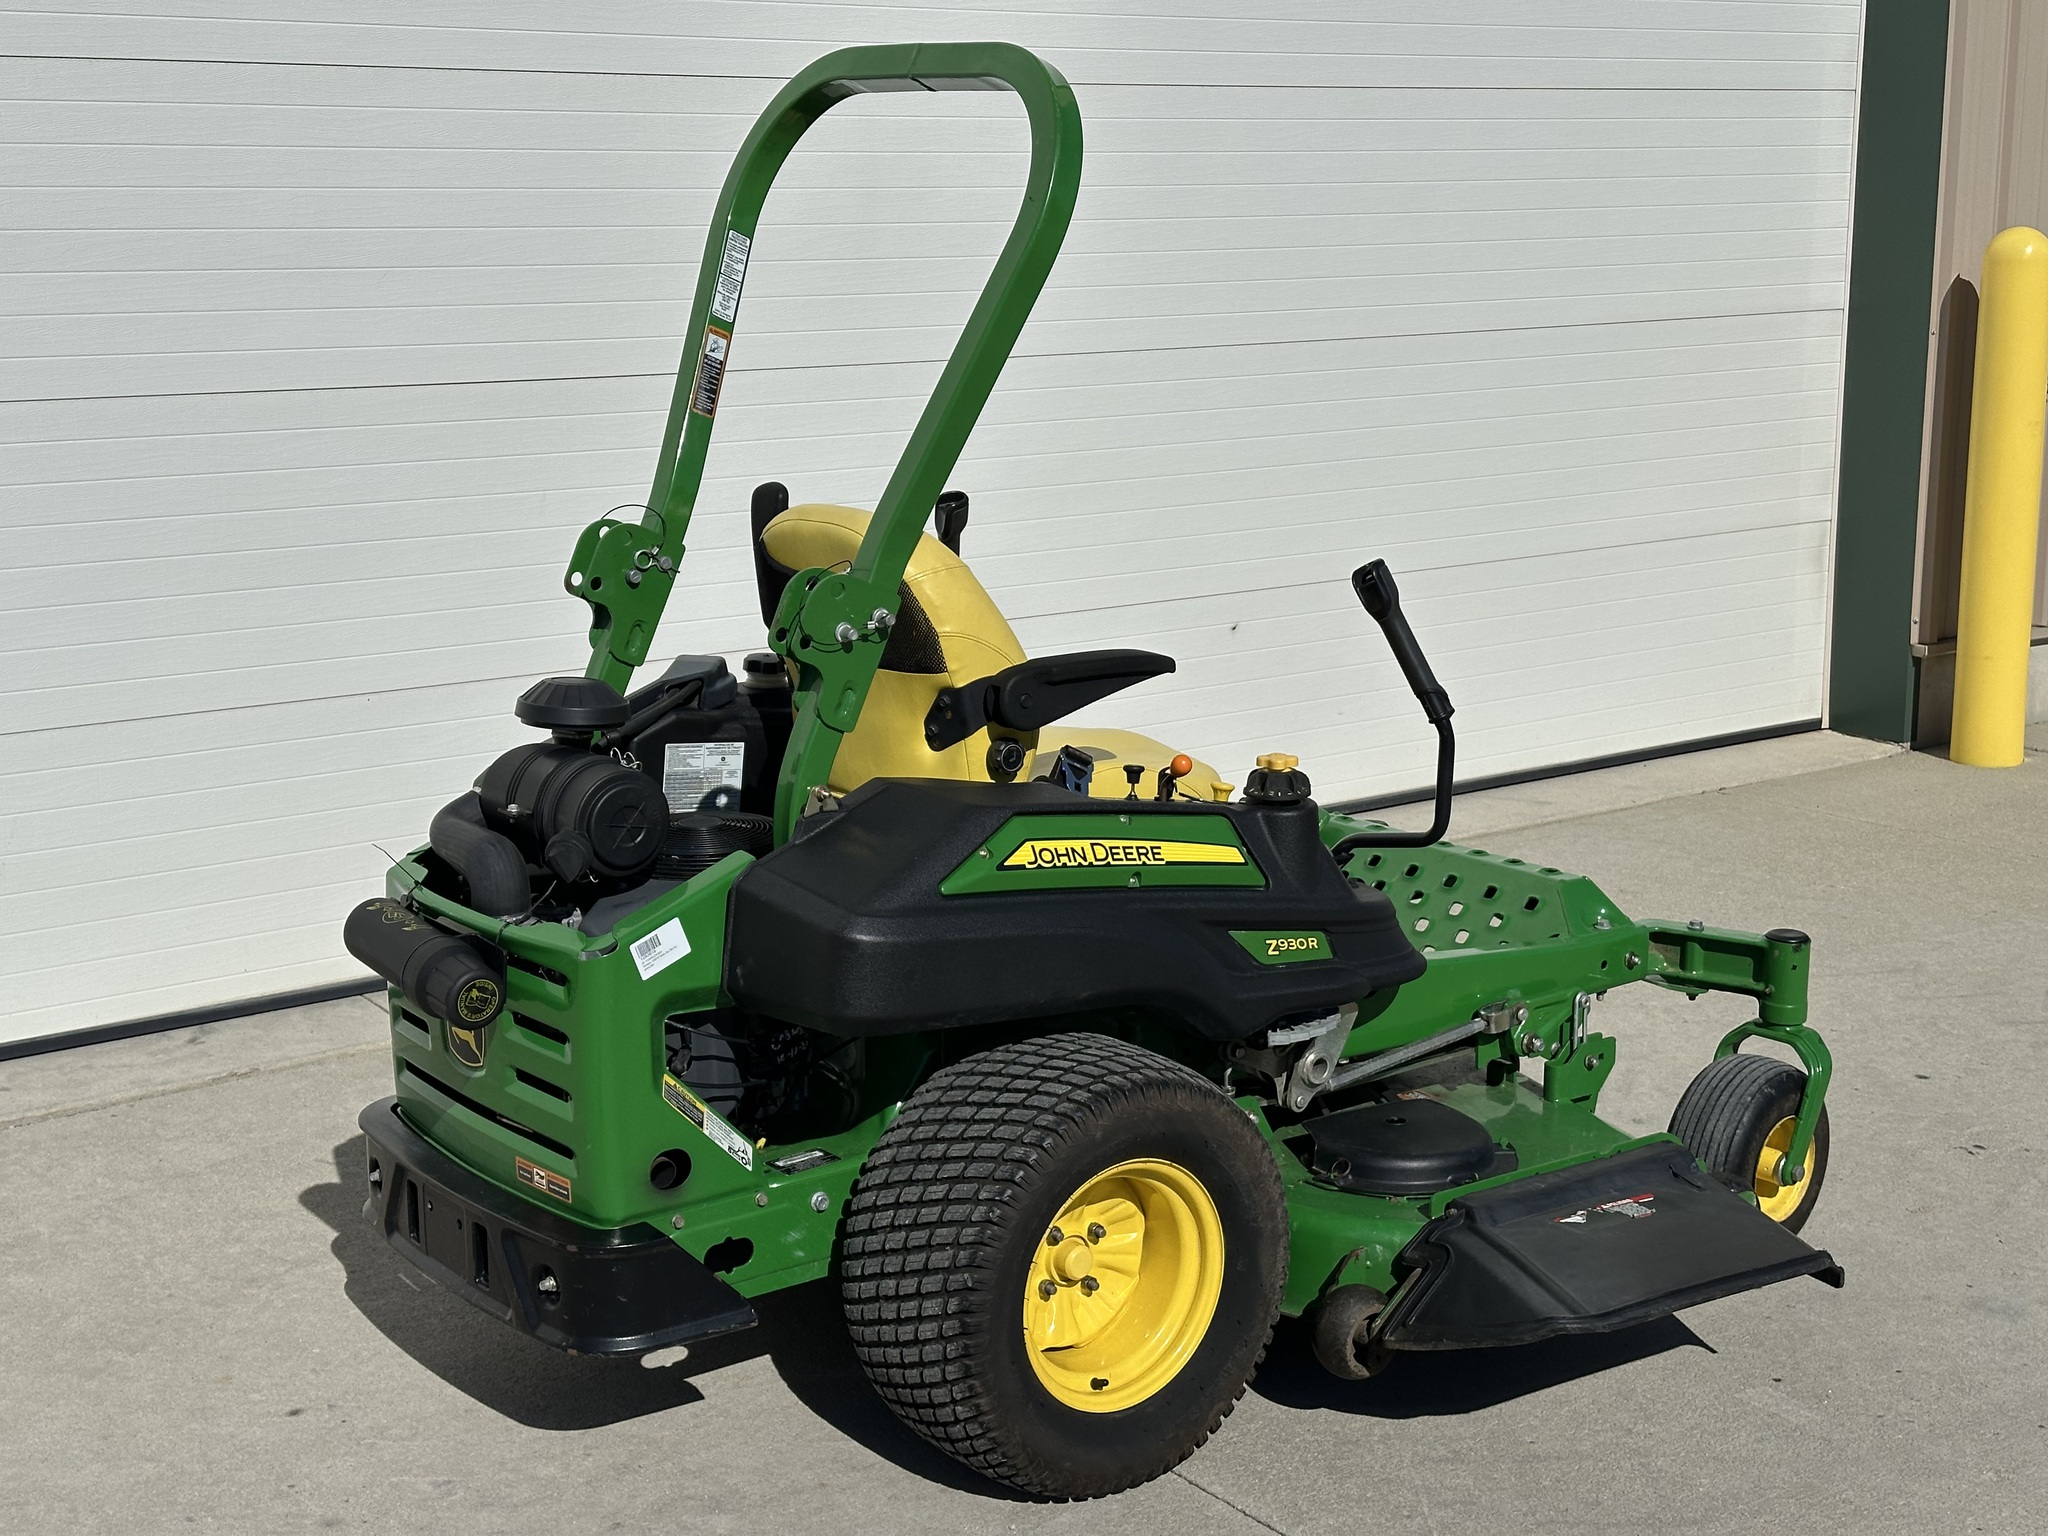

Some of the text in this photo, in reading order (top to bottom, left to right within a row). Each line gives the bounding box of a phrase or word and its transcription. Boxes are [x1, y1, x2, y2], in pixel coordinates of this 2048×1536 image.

[1027, 842, 1165, 866] JOHN DEERE
[1265, 937, 1319, 955] Z930R
